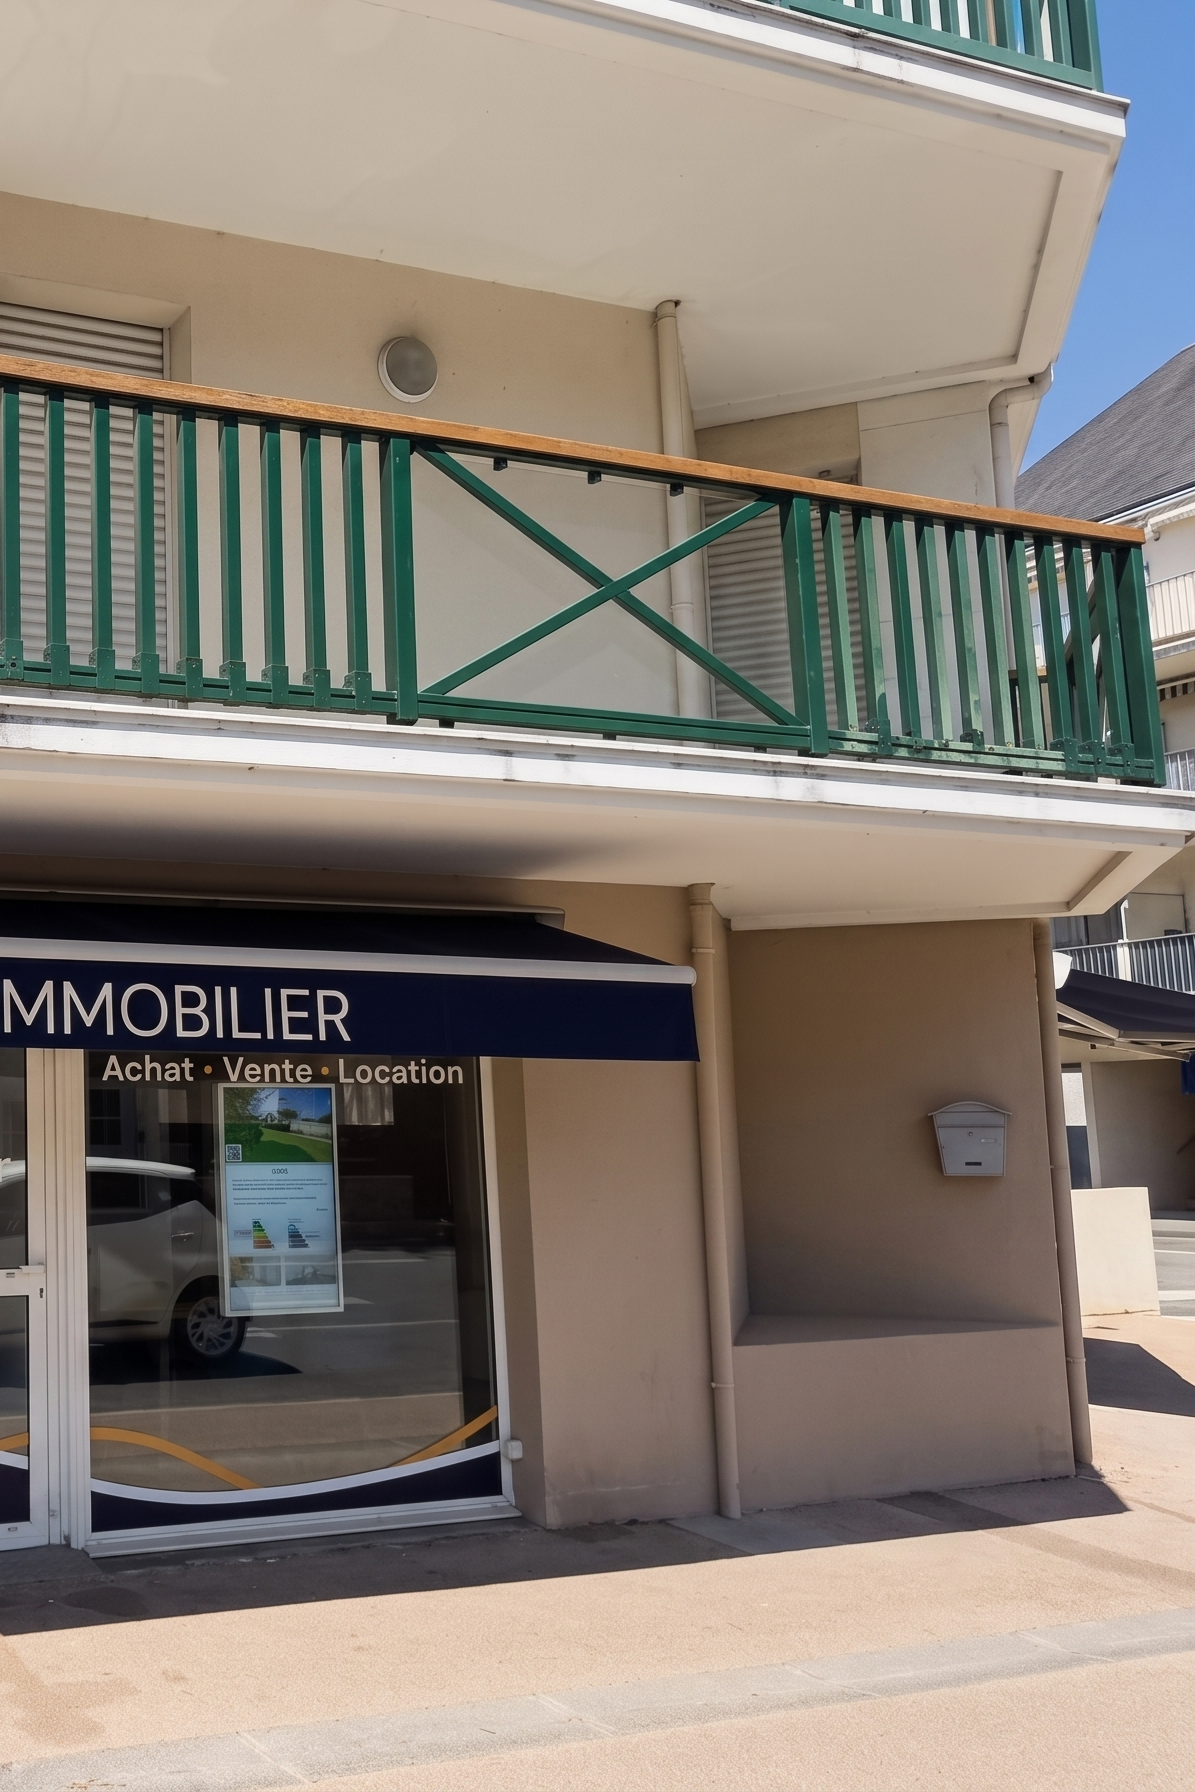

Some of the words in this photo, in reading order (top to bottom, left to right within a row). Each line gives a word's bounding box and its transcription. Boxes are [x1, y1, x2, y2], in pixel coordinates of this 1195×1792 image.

[102, 1054, 194, 1082] Achat
[222, 1056, 313, 1083] Vente
[338, 1058, 464, 1084] Location
